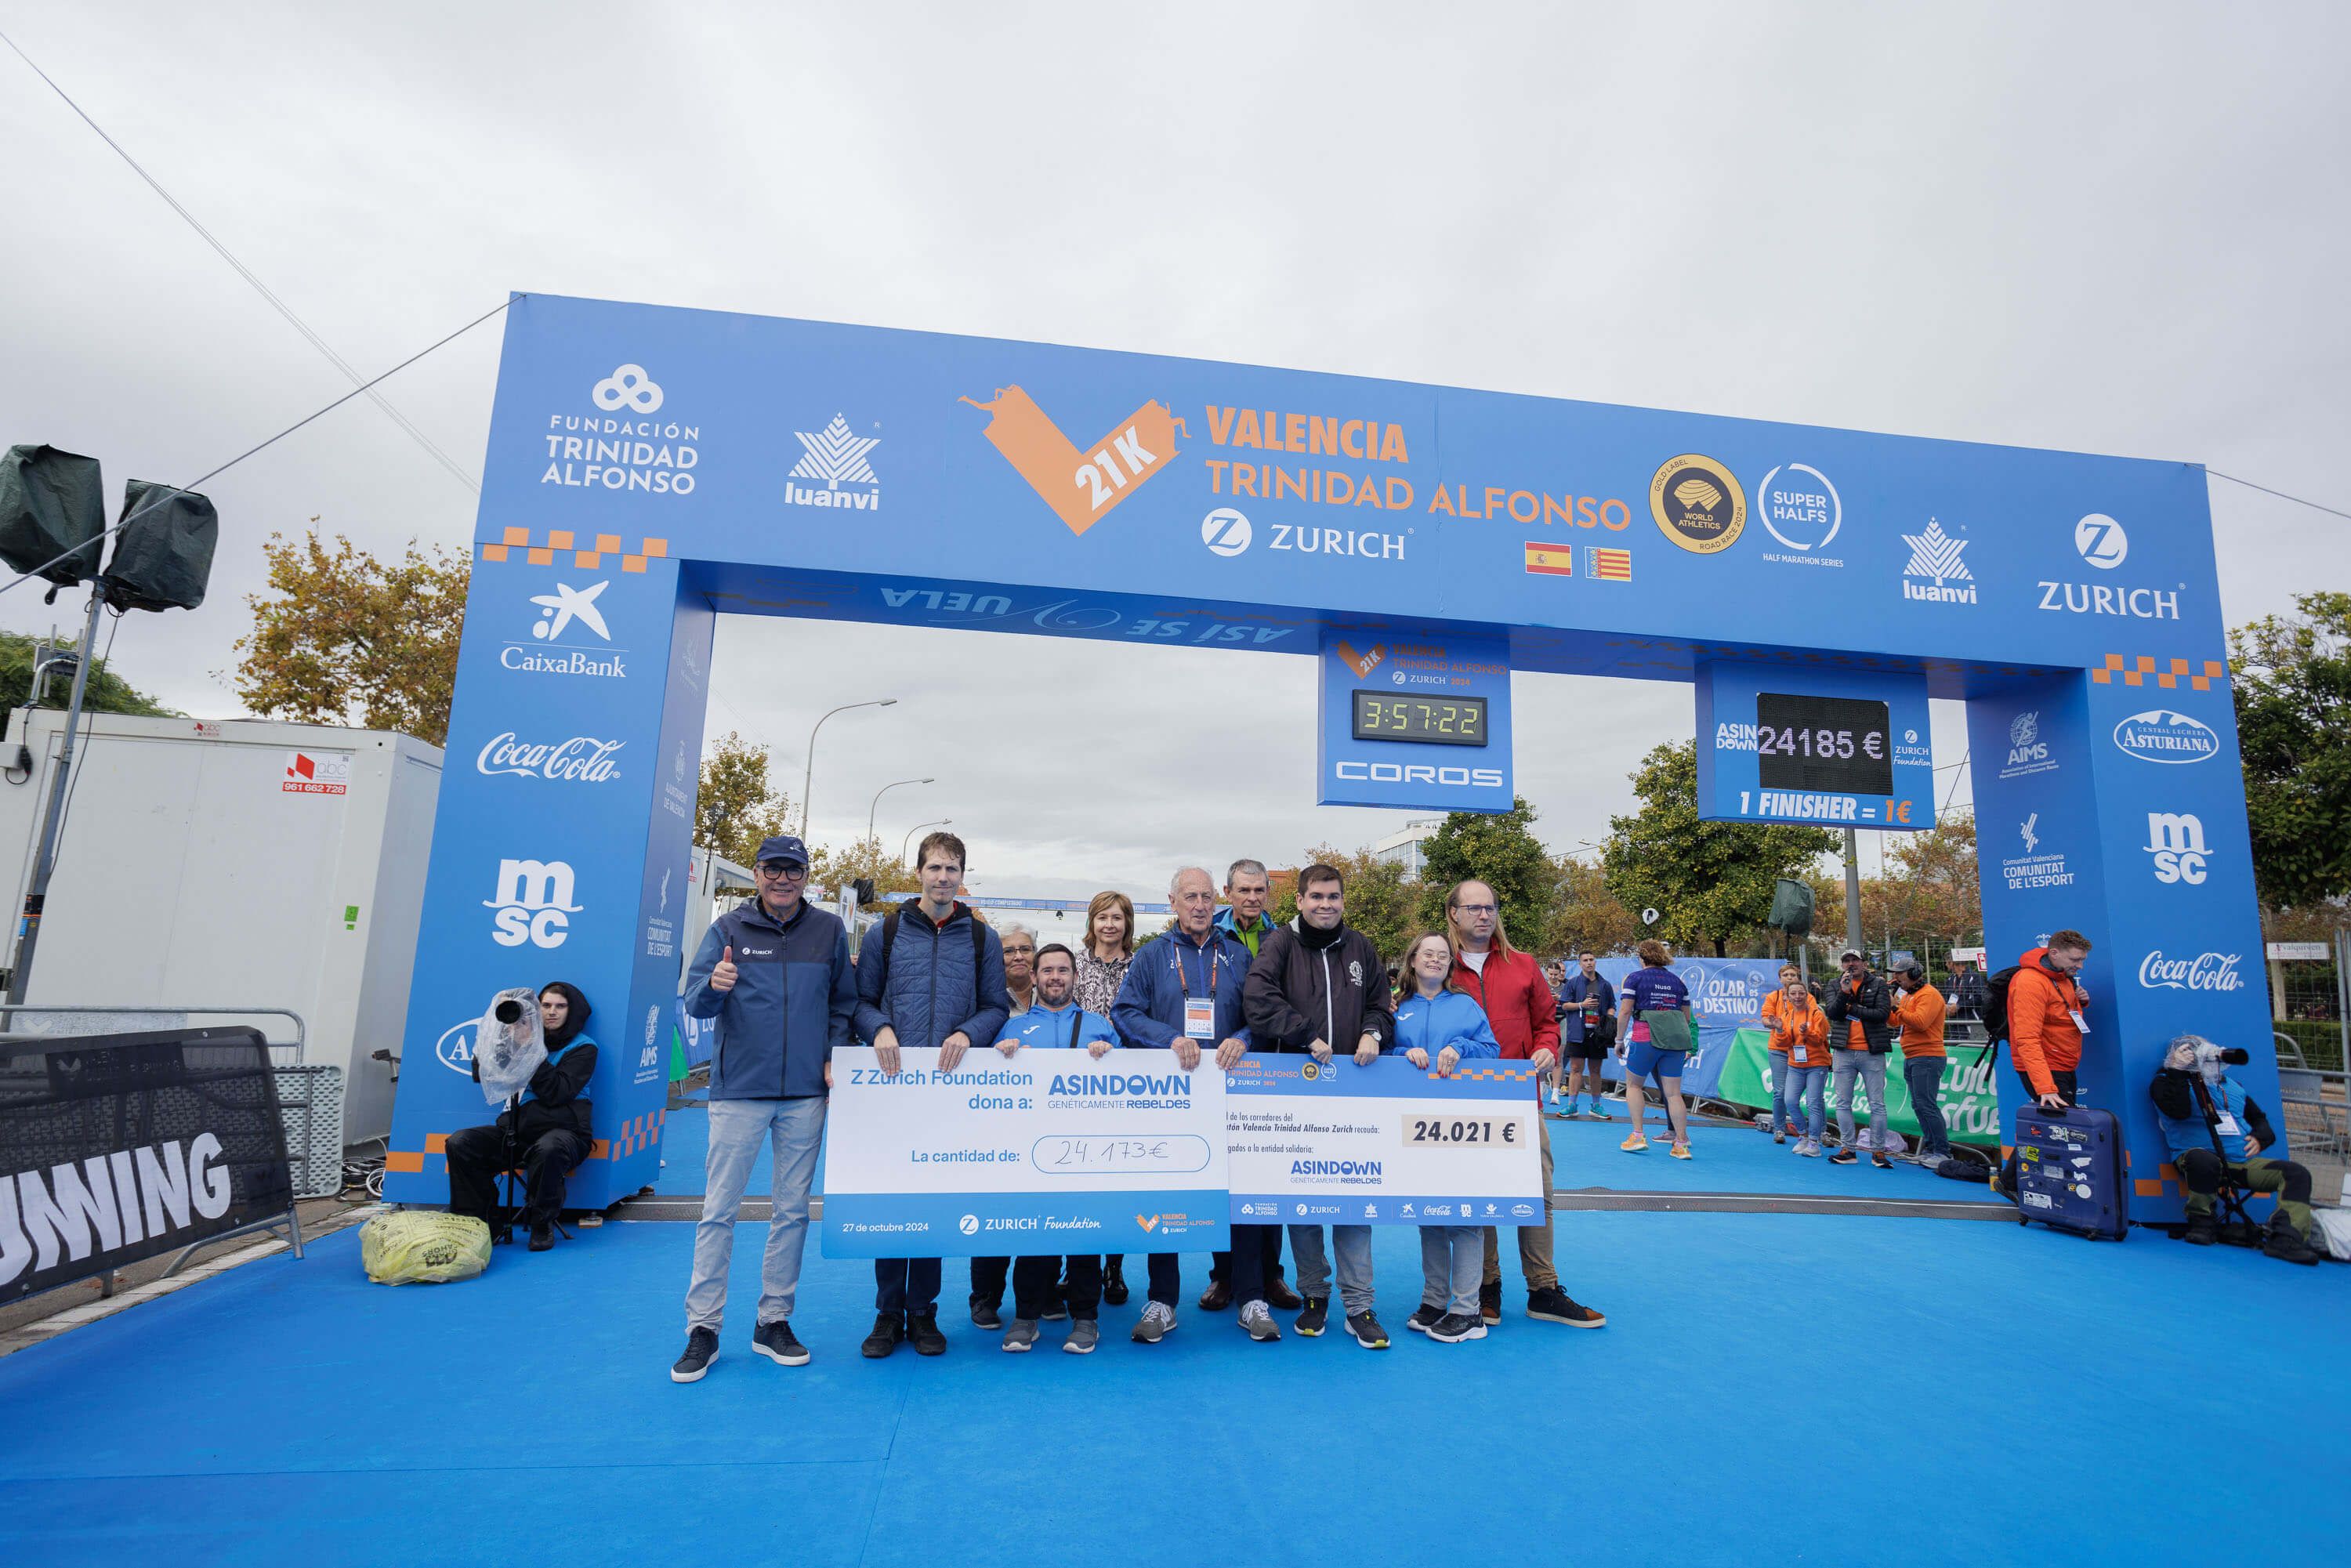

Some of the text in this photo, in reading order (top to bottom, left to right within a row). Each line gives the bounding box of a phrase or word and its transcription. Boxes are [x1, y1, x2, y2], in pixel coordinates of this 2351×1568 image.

[550, 414, 701, 440] FUNDACIÓN
[1204, 404, 1409, 463] VALENCIA
[546, 434, 698, 469] TRINIDAD
[1074, 424, 1158, 512] 21K
[1654, 459, 1689, 492] GOLD LABEL
[541, 461, 696, 495] ALFONSO
[784, 481, 879, 511] luanvi
[1205, 459, 1632, 532] TRINIDAD ALFONSO
[1773, 491, 1827, 509] SUPER
[1684, 512, 1714, 522] WORLD
[1773, 506, 1828, 523] HALFS
[1678, 520, 1721, 531] ATHLETICS
[1699, 506, 1744, 551] ROAD RACE 2024
[1269, 523, 1407, 561] ZURICH
[1762, 552, 1844, 568] HALF MARATHON SERIES
[1902, 579, 1978, 606] luanvi
[2038, 581, 2181, 621] ZURICH
[1392, 643, 1447, 657] VALENCIA
[499, 646, 628, 679] CaixaBank
[1359, 649, 1382, 674] 21K
[1392, 657, 1508, 676] TRINIDAD ALFONSO
[1410, 674, 1472, 686] ZURICH 2024
[1364, 701, 1480, 735] 3:57:22
[1716, 722, 1758, 739] ASIN
[2122, 727, 2212, 752] ASTURIANA
[1716, 737, 1759, 751] DOWN
[1757, 726, 1884, 760] 24185 €
[1896, 745, 1929, 756] ZURICH
[476, 731, 628, 783] Coca-Cola
[1893, 755, 1933, 768] Foundation
[2007, 742, 2049, 766] AIMS
[317, 759, 347, 776] abc
[1335, 761, 1504, 788] COROS
[325, 784, 345, 794] 728
[1739, 791, 1912, 823] 1 FINISHER = 1€
[2143, 812, 2214, 885] msc
[2002, 853, 2065, 866] Comunitat Valenciana
[2003, 861, 2065, 878] COMUNITAT
[2009, 873, 2075, 889] DE L'ESPORT
[481, 858, 585, 949] msc
[2138, 949, 2243, 991] Coca-Cola
[1680, 964, 1759, 999] VOLAR es
[1692, 999, 1701, 1009] tu
[1703, 996, 1759, 1015] DESTINO
[639, 1045, 659, 1068] AIMS
[851, 1068, 1034, 1086] Z Zurich Foundation
[1049, 1074, 1191, 1096] ASINDOWN
[968, 1093, 1034, 1110] dona a:
[1047, 1098, 1126, 1110] GENÉTICAMENTE
[1230, 1112, 1238, 1121] de
[1239, 1111, 1248, 1121] los
[1249, 1112, 1283, 1122] corredores
[1283, 1112, 1294, 1122] del
[1226, 1123, 1241, 1132] tón
[1242, 1123, 1272, 1132] Valencia
[1273, 1123, 1302, 1133] Trinidad
[1302, 1124, 1330, 1133] Alfonso
[1331, 1124, 1354, 1134] Zurich
[1413, 1121, 1516, 1143] 24.021 €
[911, 1149, 1021, 1163] La cantidad de:
[1053, 1139, 1170, 1165] 24.173€
[1253, 1143, 1260, 1153] la
[1261, 1144, 1284, 1153] entidad
[1290, 1160, 1382, 1176] ASINDOWN
[1310, 1205, 1341, 1214] ZURICH
[1423, 1204, 1453, 1216] Coca-Cola
[842, 1222, 929, 1233] 27 de octubre 2024
[984, 1218, 1038, 1231] ZURICH
[1043, 1215, 1102, 1232] Foundation
